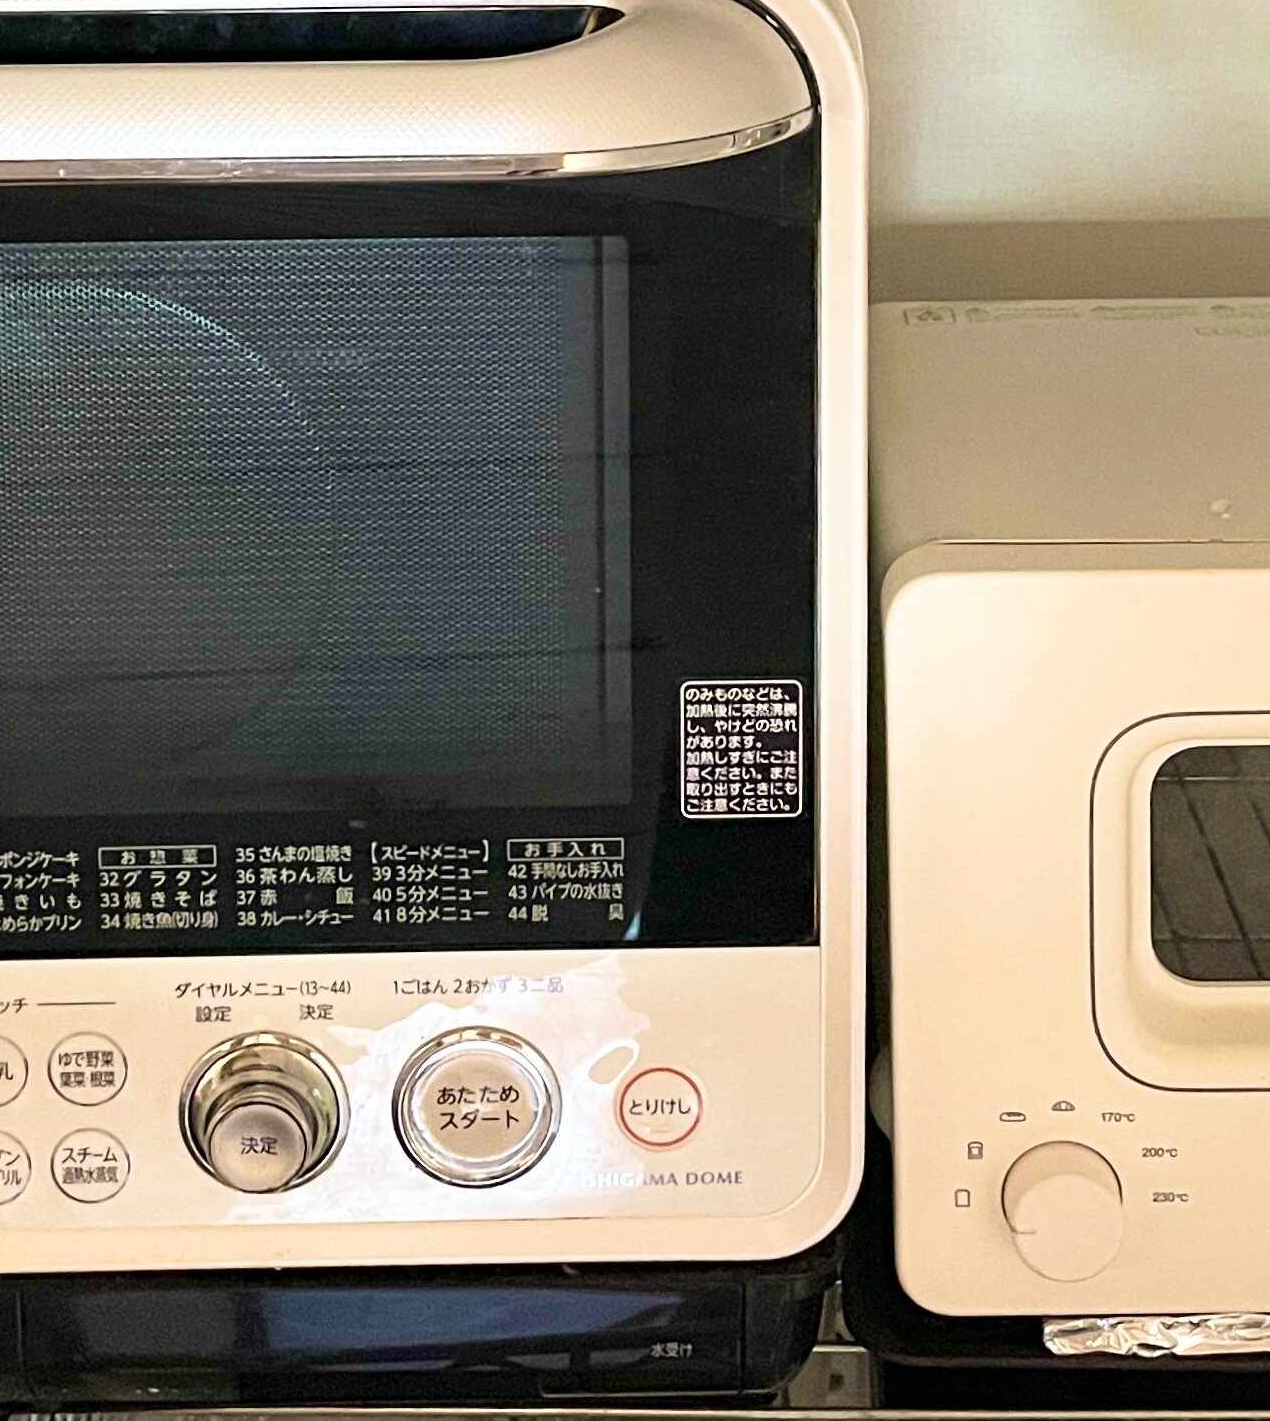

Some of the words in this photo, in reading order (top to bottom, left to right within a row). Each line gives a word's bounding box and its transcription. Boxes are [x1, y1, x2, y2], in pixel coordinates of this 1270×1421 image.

[686, 688, 790, 701] のみものなどは、
[686, 719, 797, 733] し、やけどの恐れ
[686, 736, 762, 749] があります。
[686, 783, 797, 796] 取り出すときにも
[235, 847, 255, 863] 35
[524, 842, 606, 858] お手入れ
[99, 871, 119, 887] 32
[123, 870, 217, 888] グラタン
[236, 868, 256, 884] 36
[259, 866, 354, 885] 茶わん蒸し
[372, 866, 392, 881] 39
[395, 864, 489, 882] 3分メニュー
[508, 864, 528, 879] 42
[531, 861, 624, 880] 手間なしお手入れ
[237, 890, 256, 905] 37
[373, 887, 392, 902] 40
[395, 885, 489, 903] 5分メニュー
[508, 885, 528, 899] 43
[531, 882, 623, 900] パイプの水抜き
[100, 892, 120, 908] 33
[101, 914, 120, 929] 34
[237, 911, 256, 926] 38
[373, 908, 390, 923] 41
[396, 905, 490, 923] 8分メニュー
[508, 906, 528, 920] 44
[393, 978, 447, 995] 1ごはん
[195, 1005, 232, 1023] 設定
[299, 1003, 334, 1021] 決定
[58, 1050, 114, 1068] ゆで野菜
[436, 1085, 520, 1106] あたため
[629, 1098, 692, 1116] とりけし
[439, 1109, 520, 1131] スタート
[240, 1136, 279, 1156] 決定
[61, 1146, 118, 1165] スチーム
[685, 1170, 743, 1185] DOME
[650, 1341, 693, 1358] 水受け
